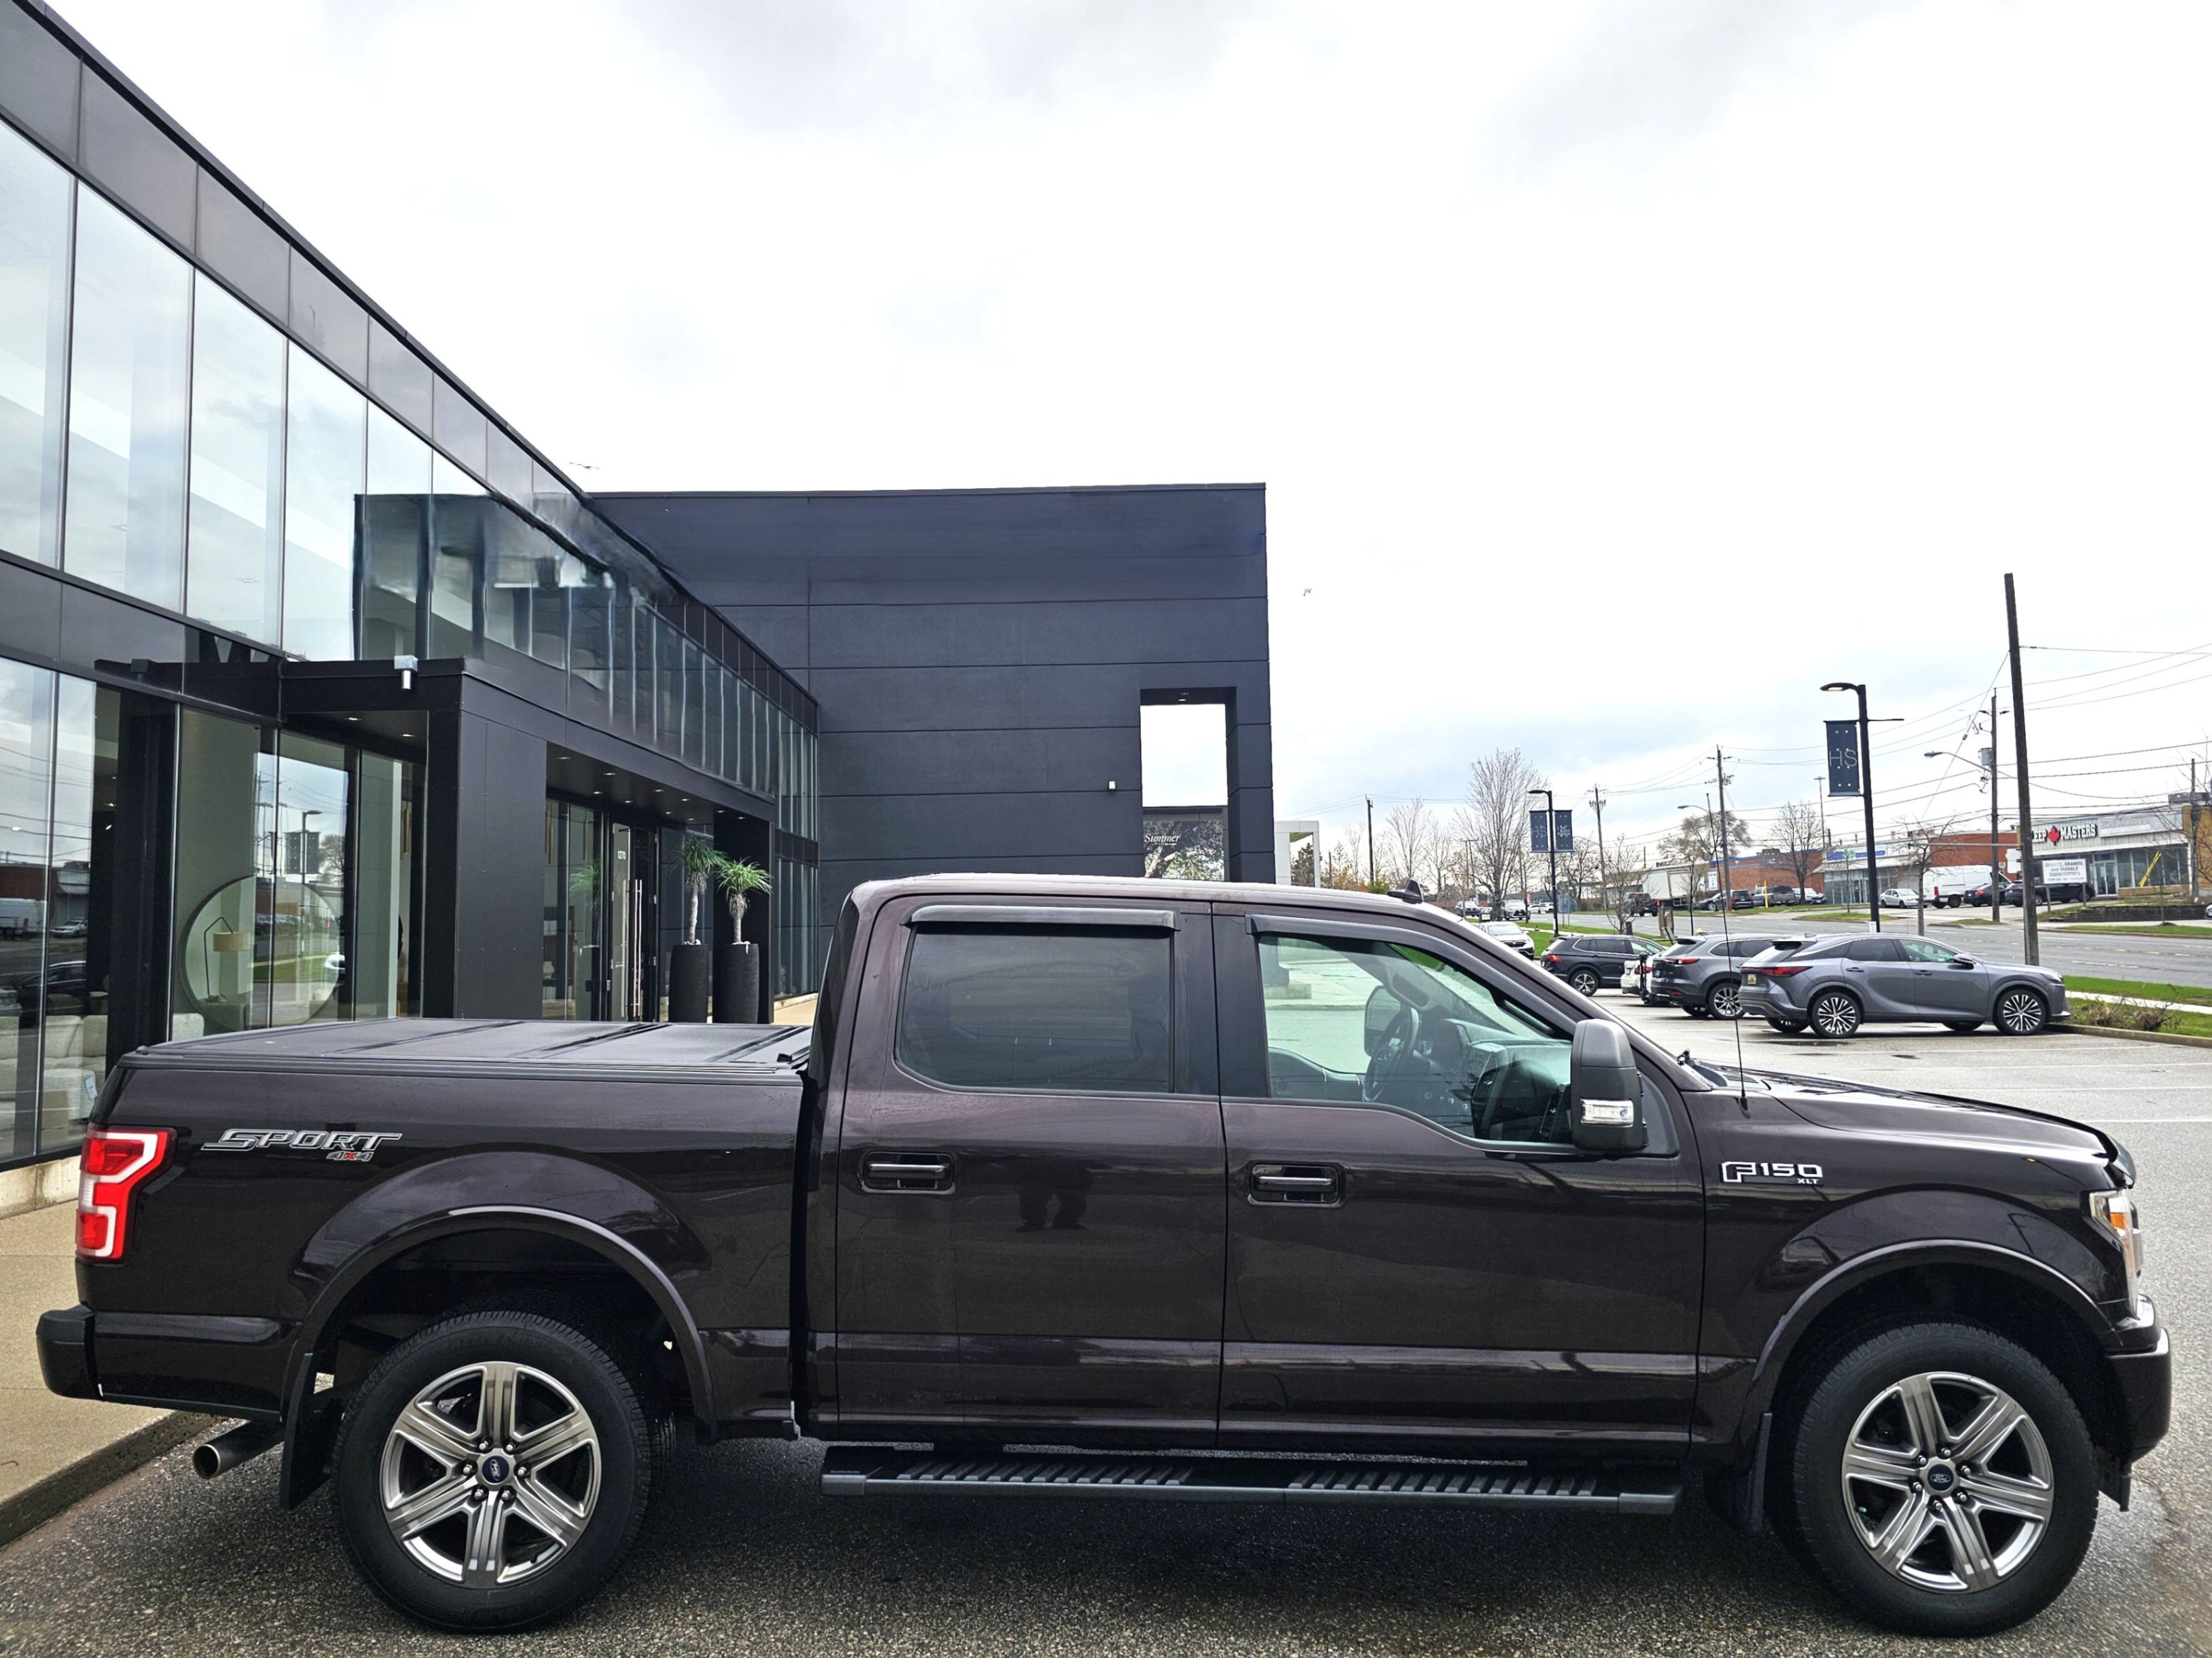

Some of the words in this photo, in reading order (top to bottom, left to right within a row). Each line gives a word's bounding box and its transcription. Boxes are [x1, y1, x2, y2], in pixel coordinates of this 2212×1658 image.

[1829, 750, 1857, 767] HS
[1144, 833, 1180, 843] Summer
[2060, 824, 2097, 841] MASTERS
[200, 1128, 403, 1152] SPORT
[1932, 1473, 1949, 1482] Ford
